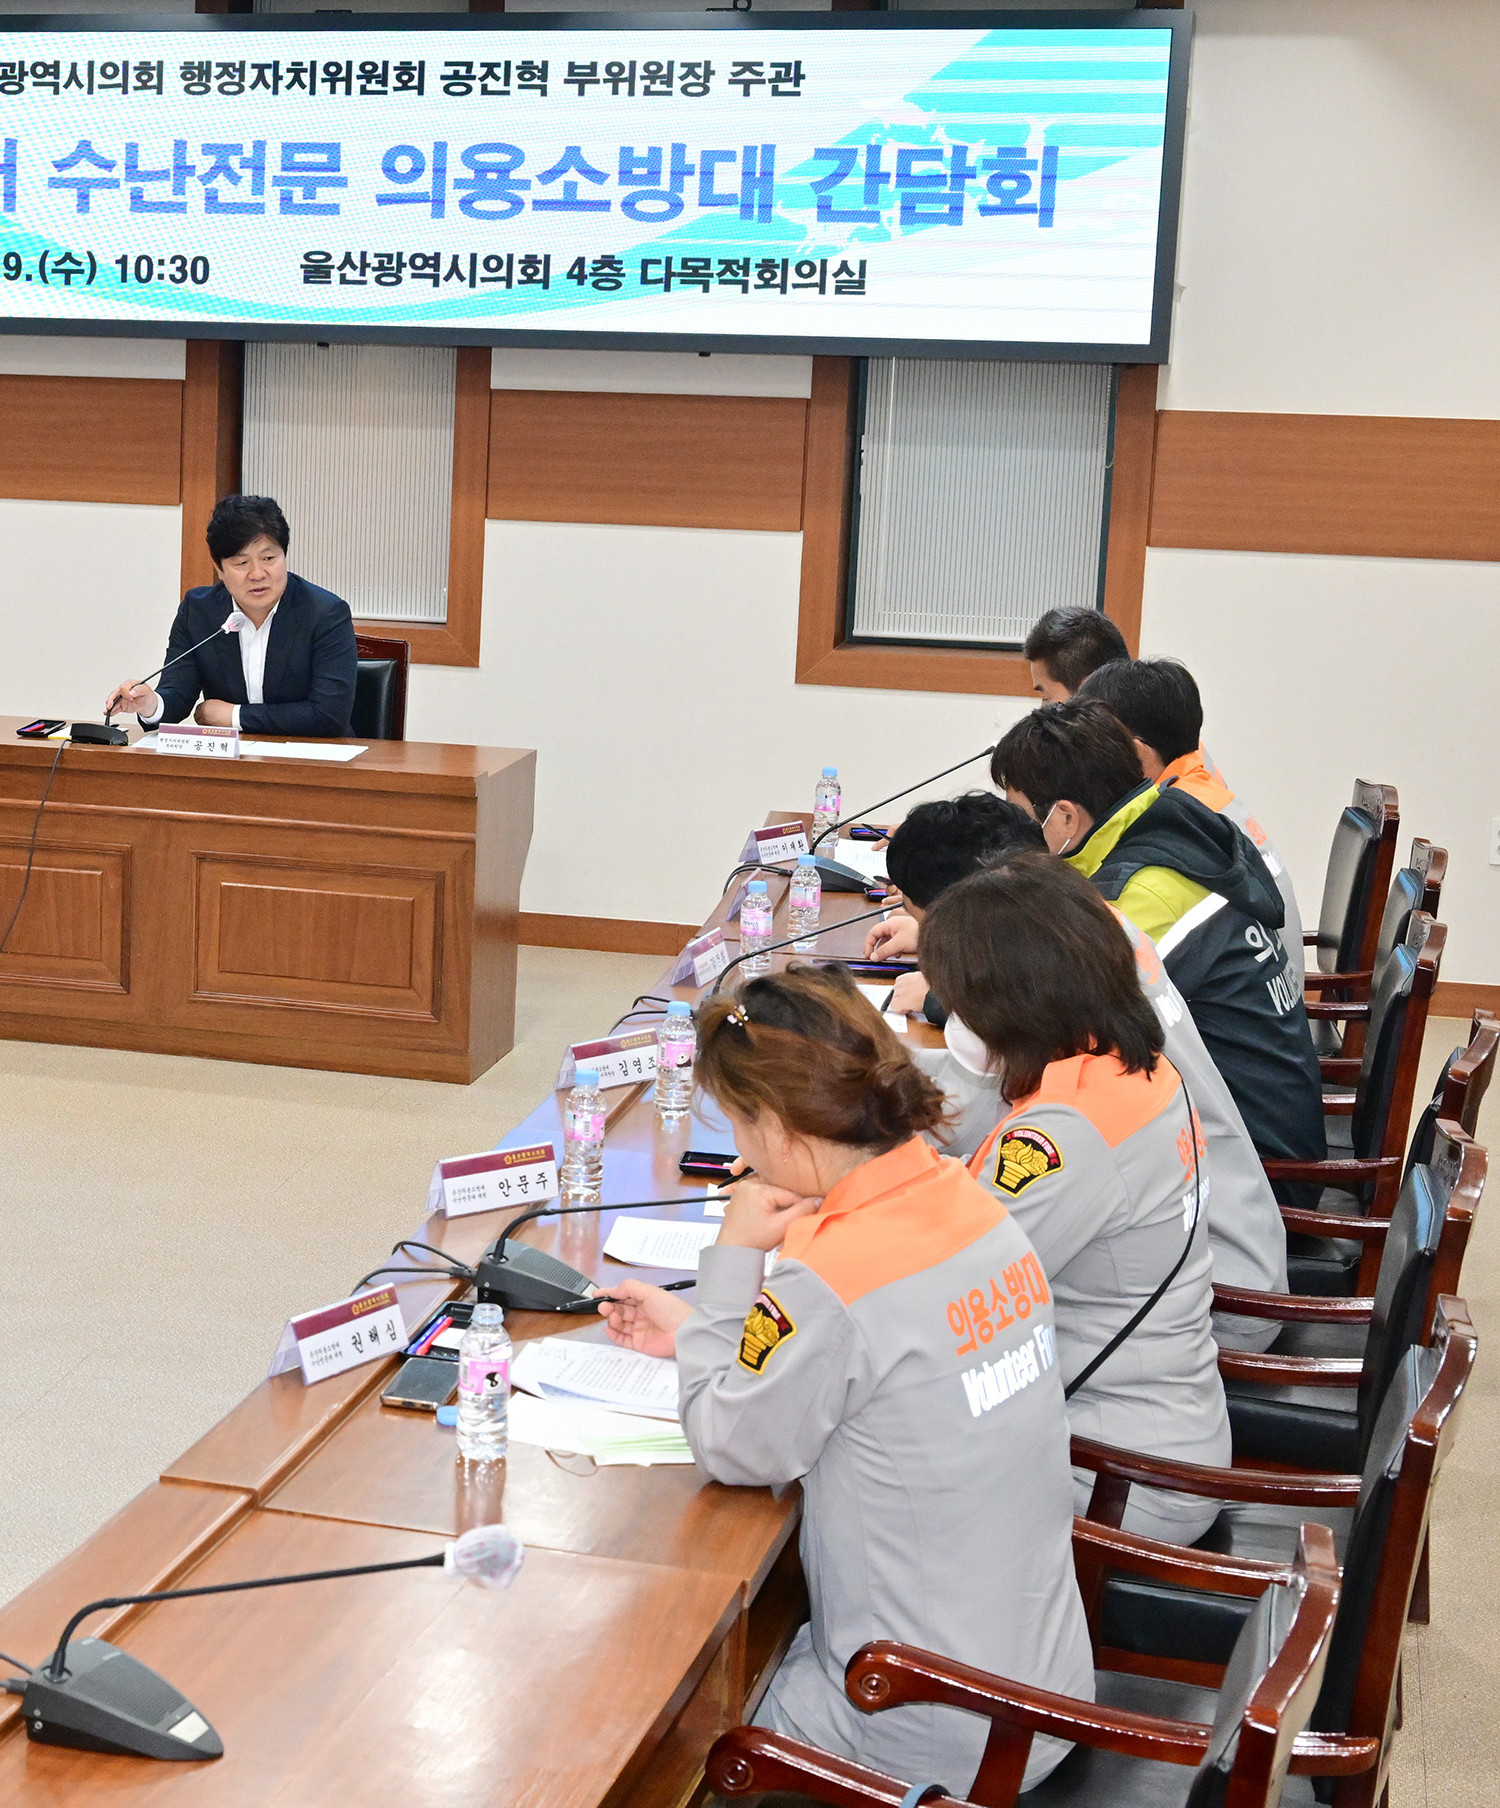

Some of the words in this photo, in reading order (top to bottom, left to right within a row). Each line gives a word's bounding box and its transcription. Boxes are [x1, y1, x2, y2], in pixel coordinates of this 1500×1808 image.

[180, 60, 426, 97] 행정자치위원회
[440, 60, 549, 97] 공진혁
[563, 60, 716, 97] 부위원장
[728, 61, 806, 97] 주관
[48, 139, 348, 216] 수난전문
[375, 141, 776, 223] 의용소방대
[810, 144, 1060, 228] 간담회
[115, 254, 210, 285] 10:30
[299, 250, 551, 290] 울산광역시의회
[566, 254, 626, 291] 4층
[640, 256, 867, 295] 다목적회의실
[194, 740, 229, 753] 공진혁
[1041, 1140, 1057, 1157] FIRE
[498, 1171, 549, 1198] 안문주
[946, 1250, 1051, 1357] 의용소방대
[960, 1339, 1041, 1419] Volunteer
